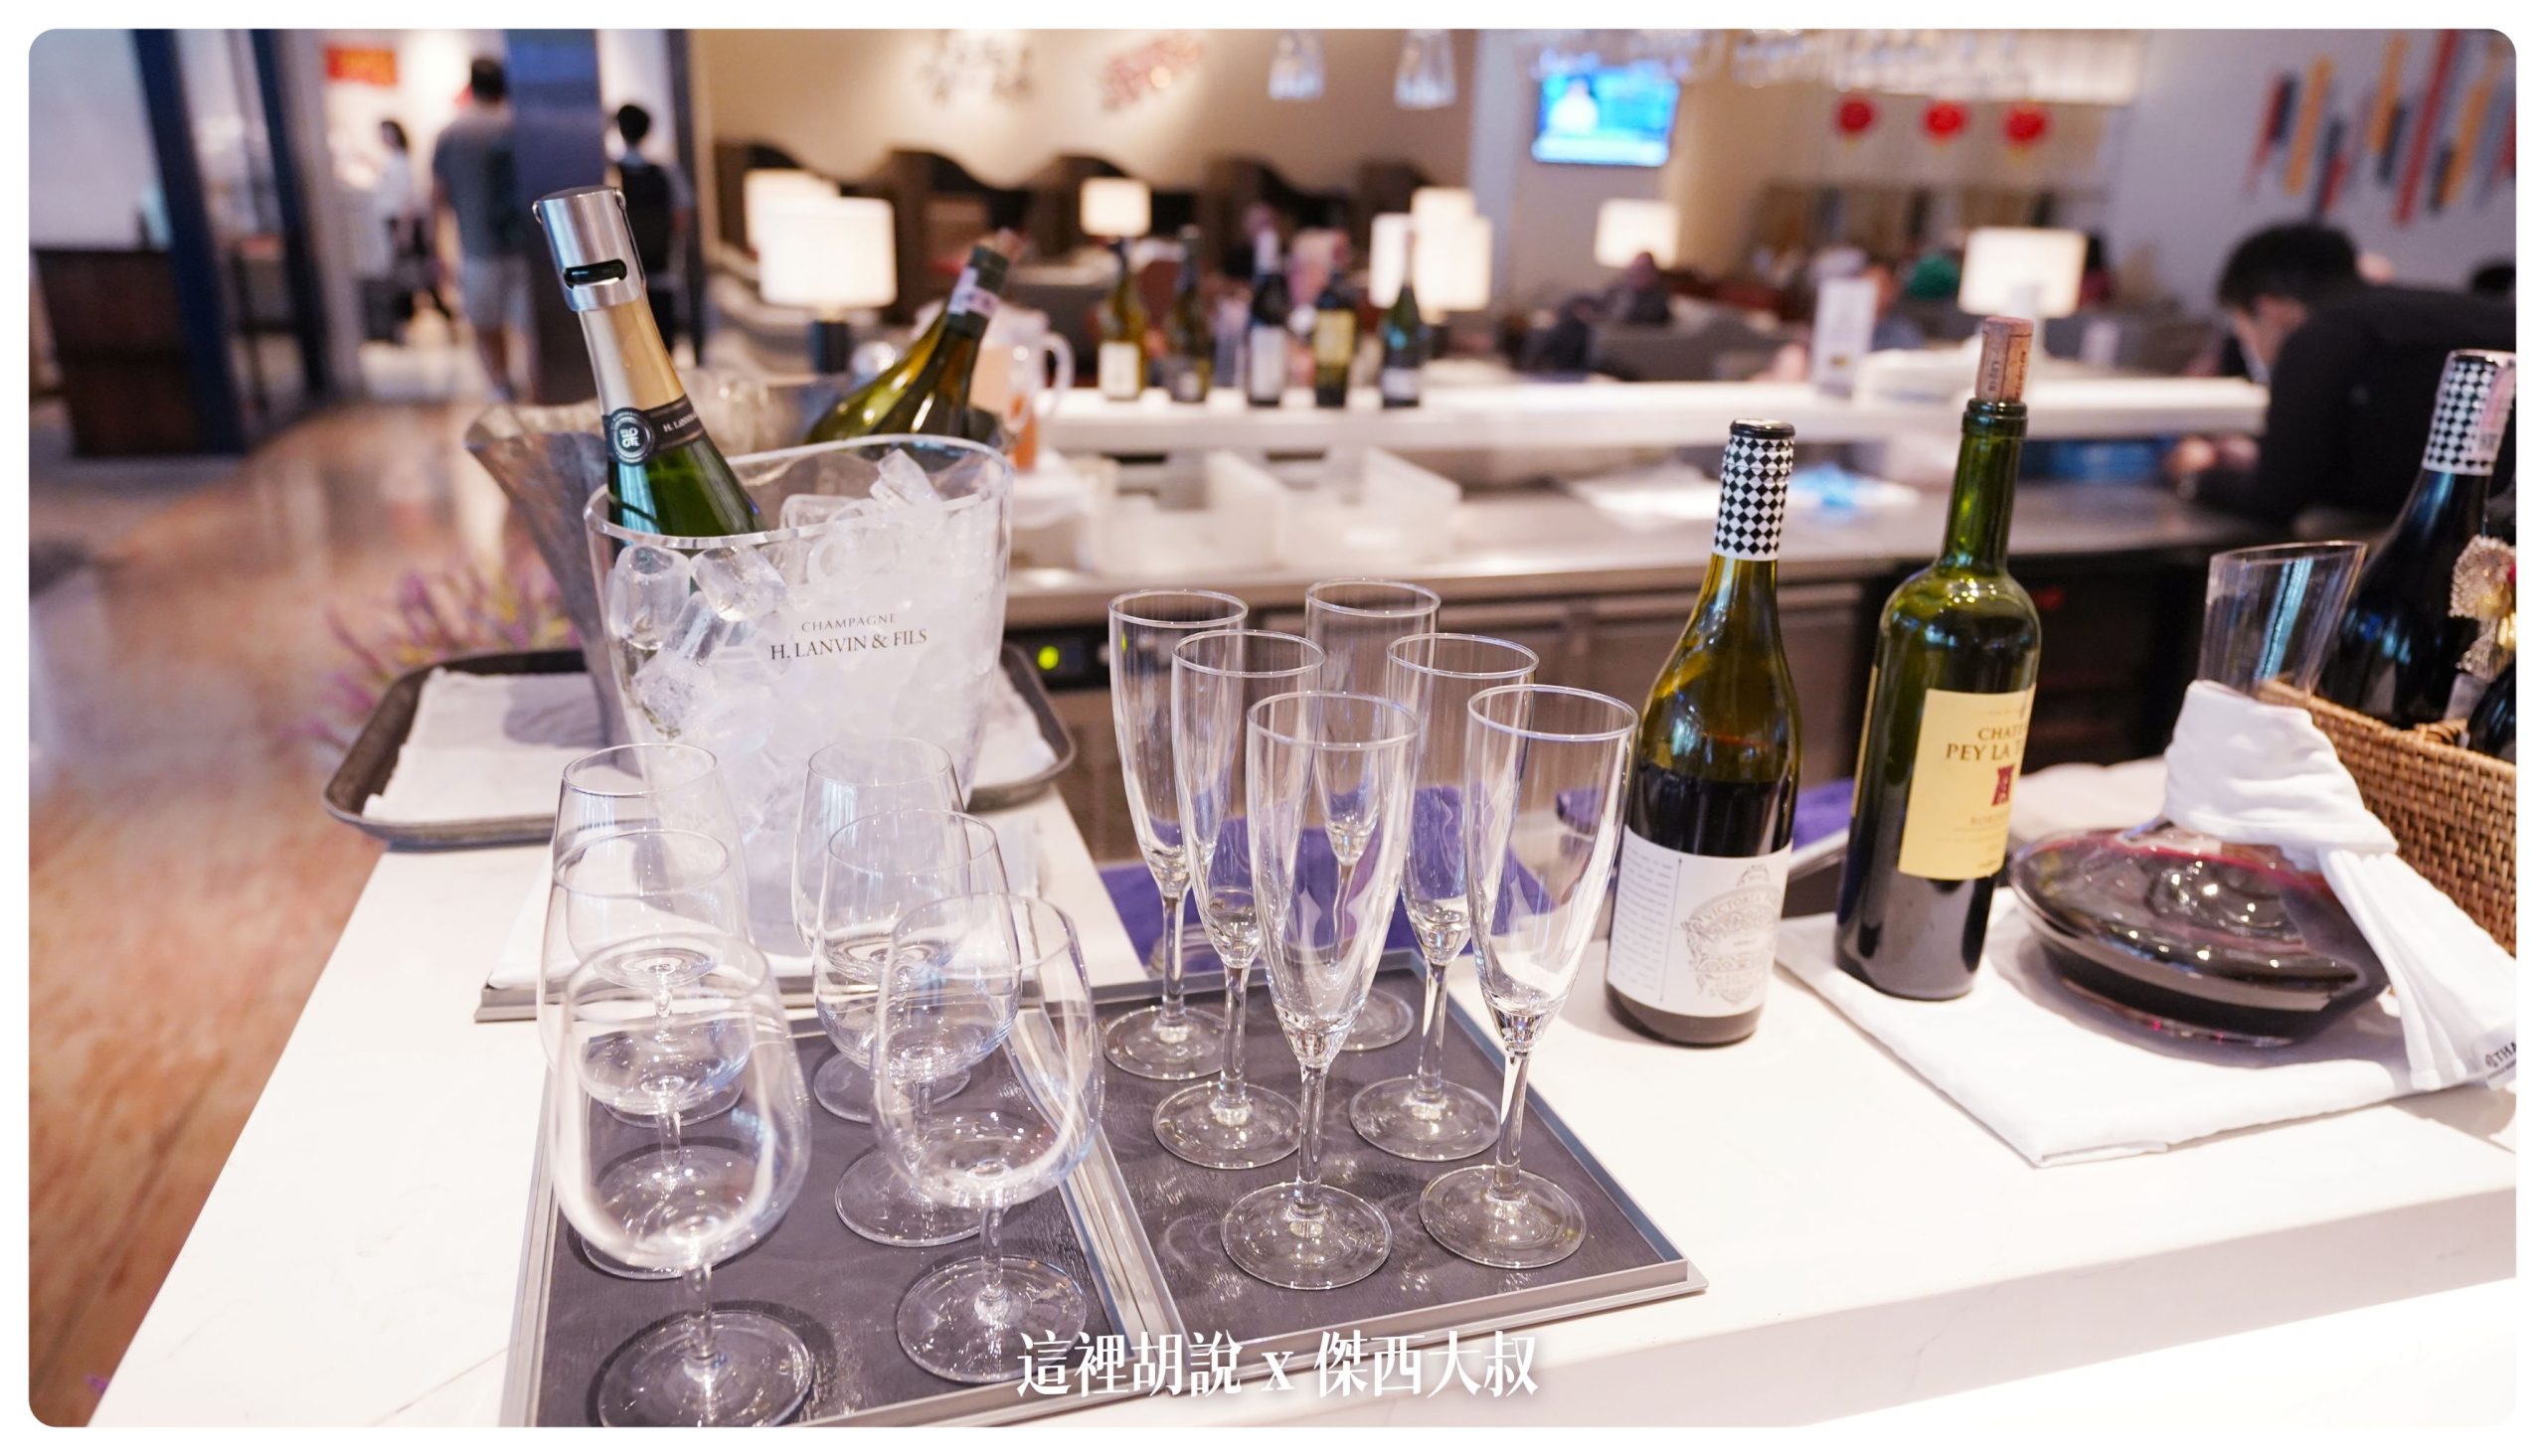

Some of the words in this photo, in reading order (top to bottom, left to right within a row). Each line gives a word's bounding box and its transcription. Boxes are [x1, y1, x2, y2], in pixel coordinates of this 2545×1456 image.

[801, 613, 896, 632] CHAMPAGNE
[770, 644, 791, 660] H.
[795, 635, 868, 657] LANVIN
[871, 633, 889, 648] &
[893, 628, 928, 646] FILS
[1945, 742, 1988, 761] PEY
[1990, 743, 2012, 761] LA
